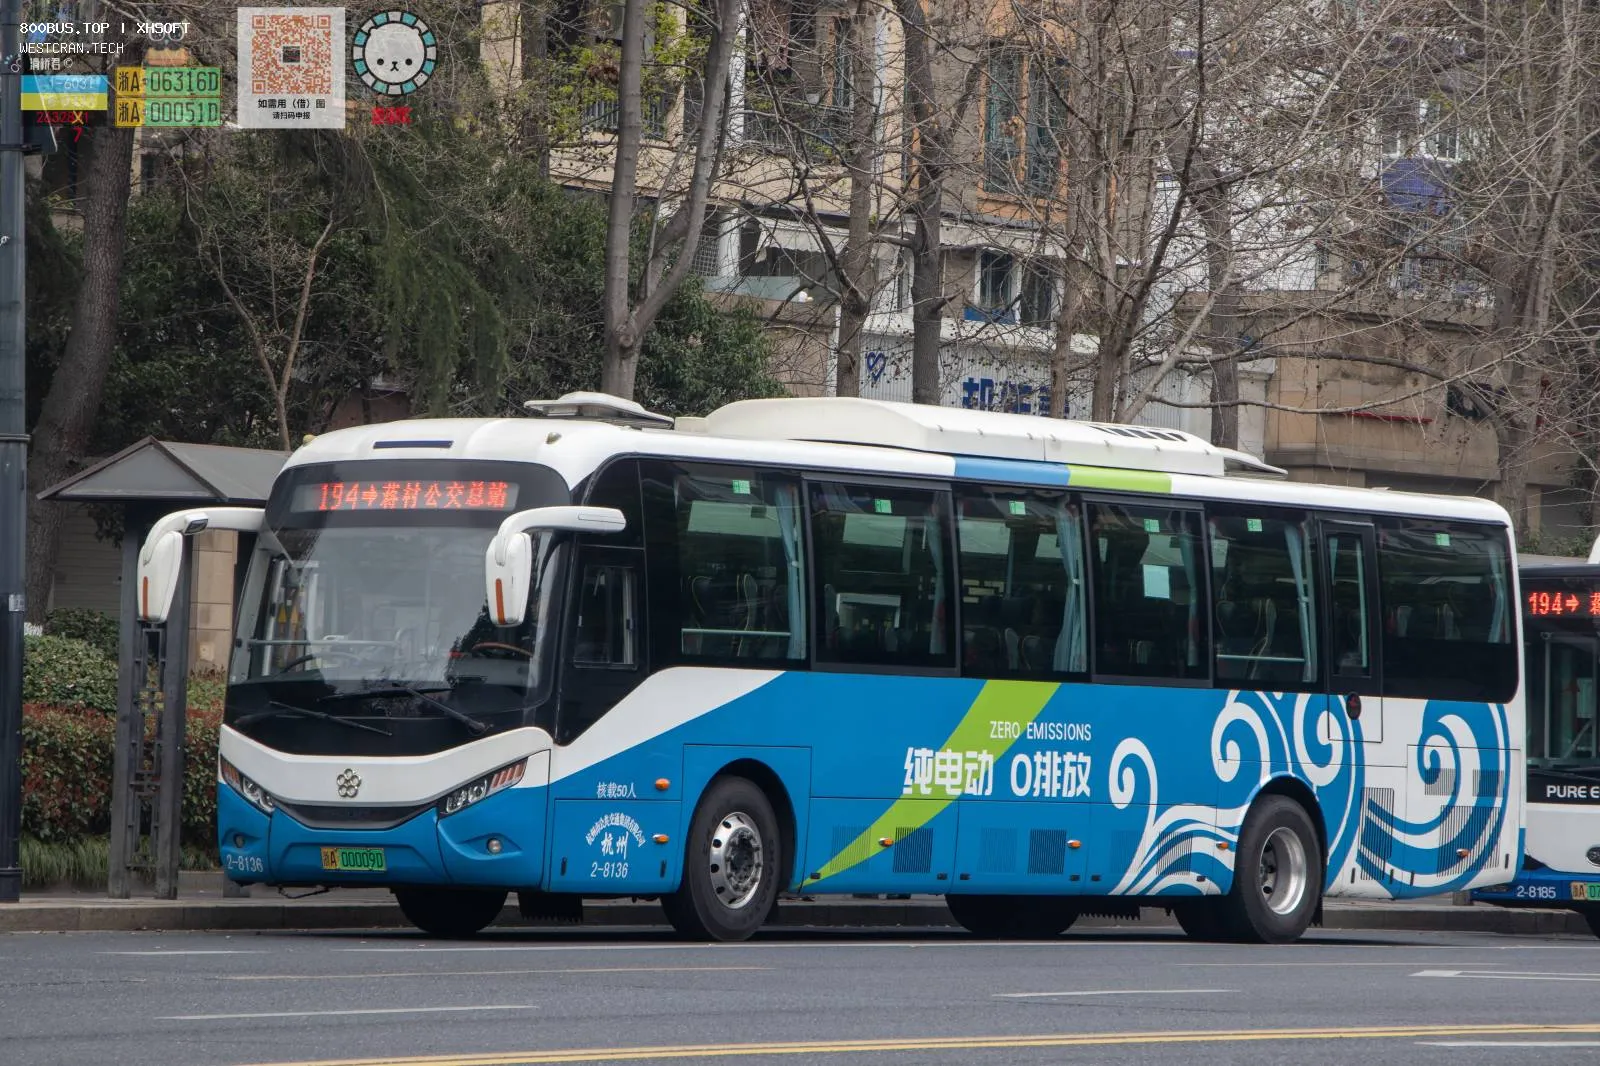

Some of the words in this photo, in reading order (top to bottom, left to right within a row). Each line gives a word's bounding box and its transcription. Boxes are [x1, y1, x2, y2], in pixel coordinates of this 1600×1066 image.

[319, 482, 359, 511] 194
[380, 481, 509, 510] 蒋村公交总站
[1529, 592, 1563, 615] 194
[990, 721, 1020, 739] ZERO
[1026, 722, 1092, 741] EMISSIONS
[902, 747, 994, 797] 纯电动
[1010, 750, 1092, 798] 0排放
[596, 781, 637, 799] 核载50人
[1546, 785, 1587, 799] PURE
[601, 831, 629, 860] 杭州
[226, 854, 263, 873] 2-8136
[590, 861, 629, 878] 2-8136
[1516, 885, 1557, 899] 2-8185
